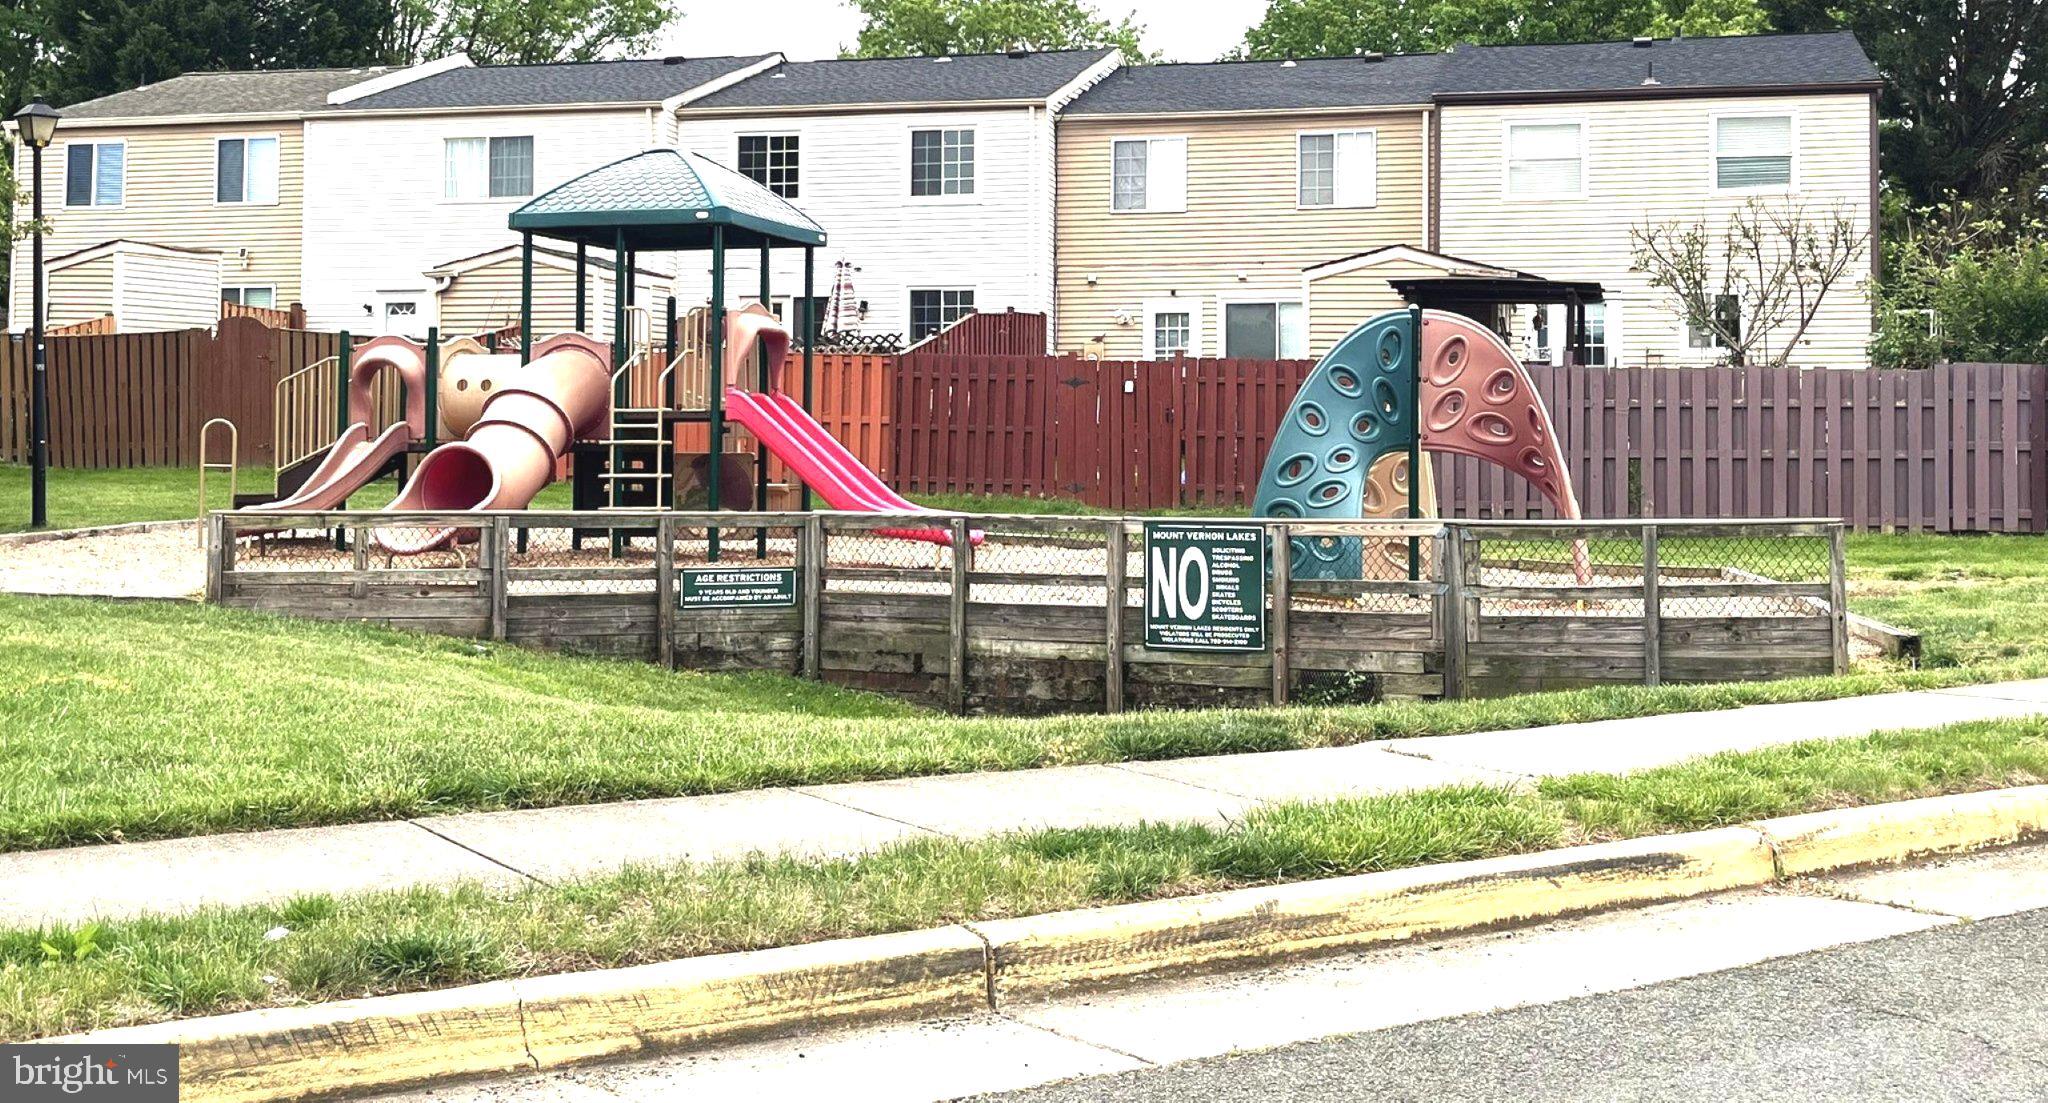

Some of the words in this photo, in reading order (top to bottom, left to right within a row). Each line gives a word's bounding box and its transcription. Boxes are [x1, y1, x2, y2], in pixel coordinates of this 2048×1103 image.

[1153, 532, 1184, 540] MOUNT
[1186, 532, 1224, 540] VERNON
[1226, 533, 1256, 541] LAKES
[717, 574, 782, 582] RESTRICTIONS
[1152, 547, 1208, 620] NO
